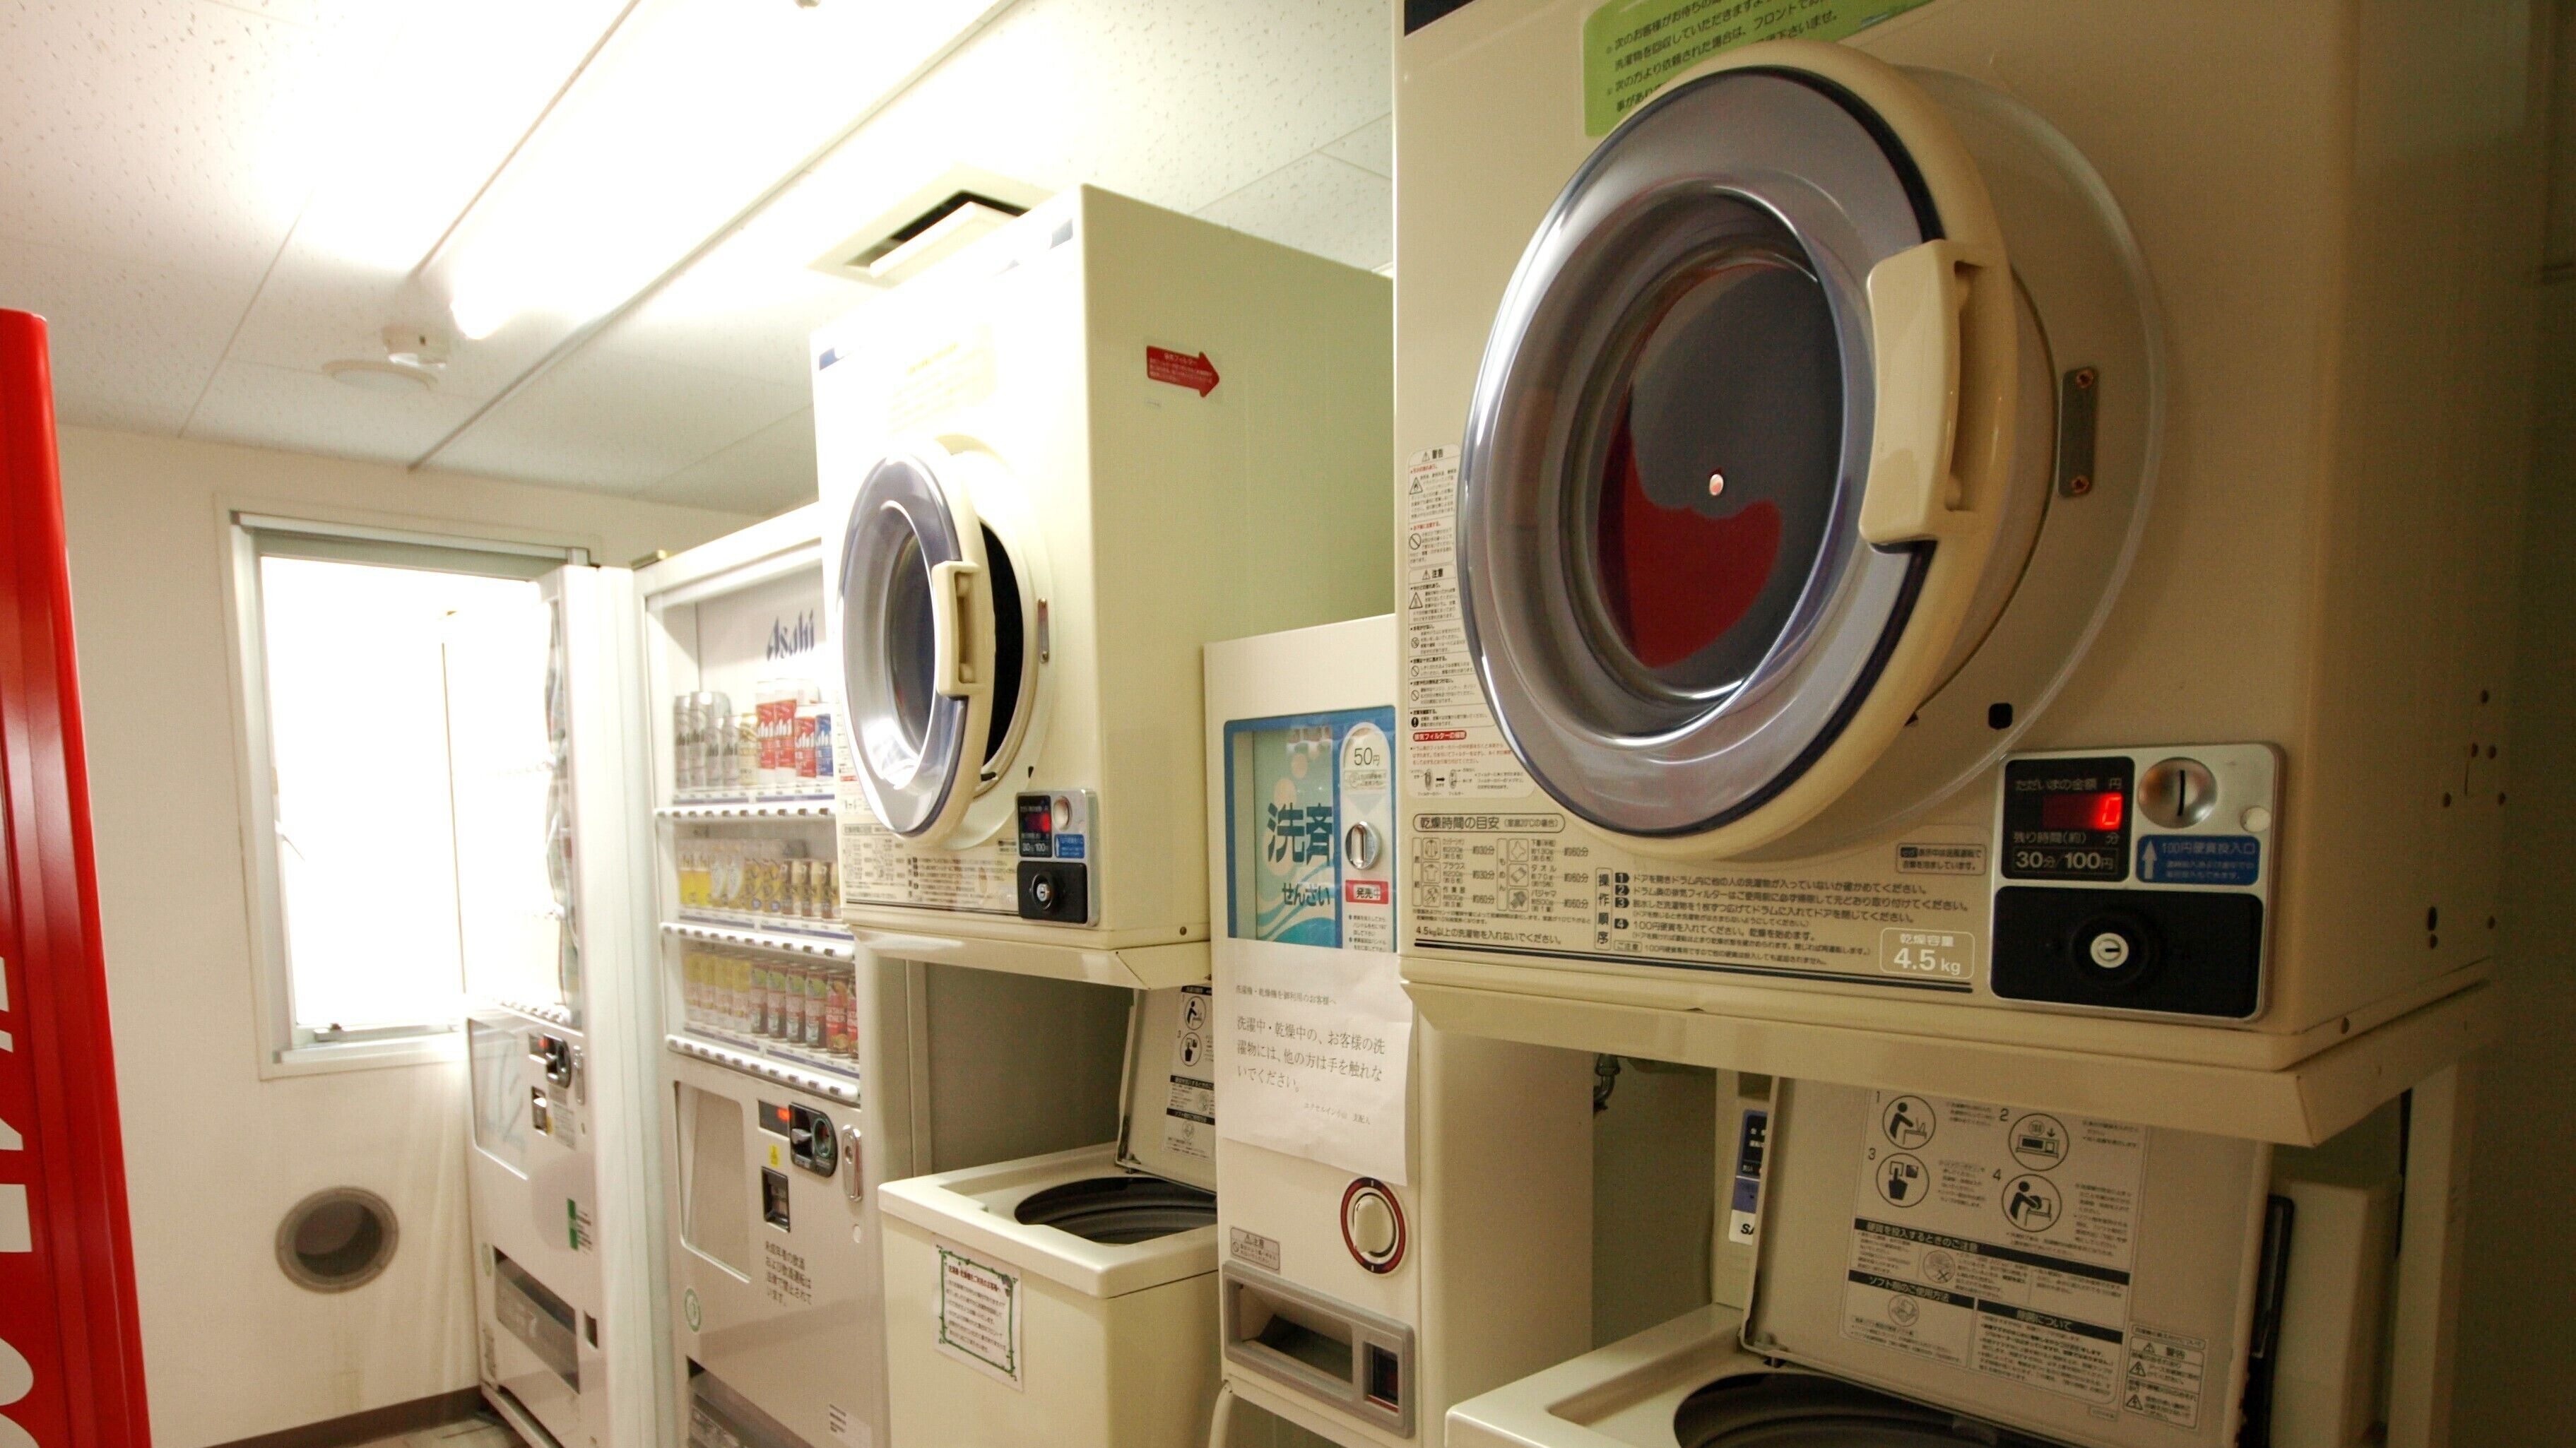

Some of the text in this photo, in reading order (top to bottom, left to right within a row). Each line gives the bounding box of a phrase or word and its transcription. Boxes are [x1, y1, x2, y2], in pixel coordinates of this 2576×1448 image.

[766, 607, 815, 661] Asahi
[1354, 747, 1380, 766] 50円
[1420, 817, 1500, 829] 乾燥時間の目安
[2102, 795, 2122, 826] 0
[1282, 883, 1330, 906] せんざい
[1893, 947, 1961, 975] 4.5 kg
[1237, 1065, 1300, 1093] いでください。
[1999, 1108, 2010, 1122] 2
[1867, 1147, 2002, 1182] 3 4
